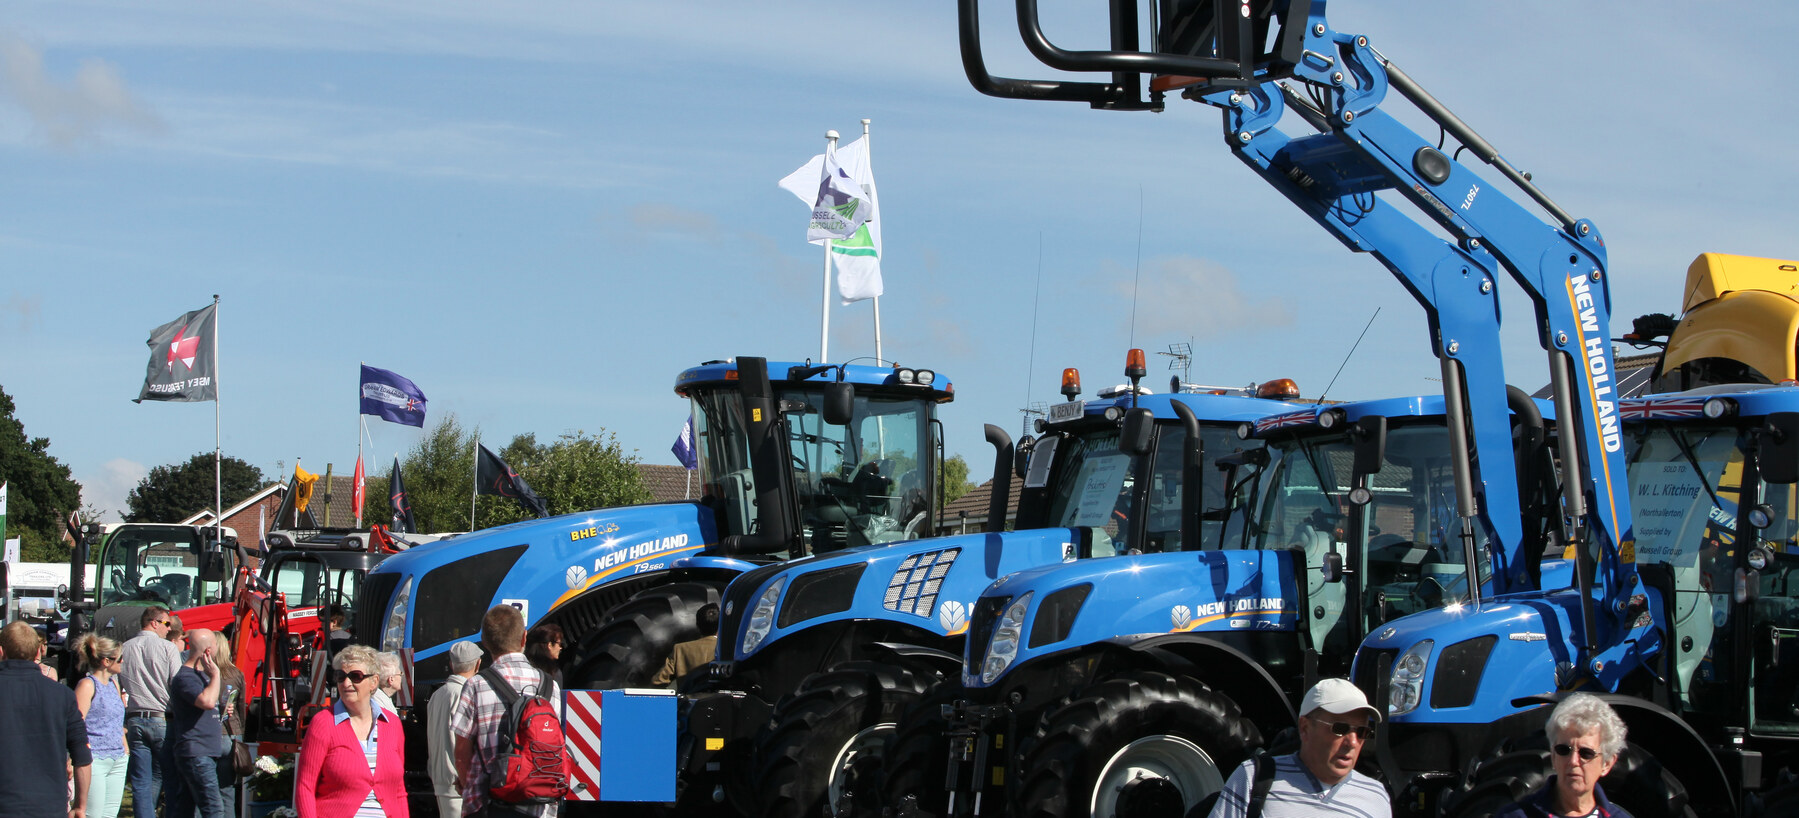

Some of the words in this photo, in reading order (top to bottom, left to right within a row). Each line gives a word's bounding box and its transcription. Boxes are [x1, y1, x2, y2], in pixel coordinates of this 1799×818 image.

[1461, 184, 1480, 210] 750TL
[1571, 274, 1599, 332] NEW
[1585, 337, 1621, 453] HOLLAND
[1638, 484, 1649, 496] W.
[1652, 485, 1659, 496] L.
[1662, 484, 1701, 499] Kitching
[1639, 508, 1684, 518] (Northallerton)
[571, 527, 597, 541] BHE
[1639, 528, 1663, 536] Supplied
[1664, 528, 1672, 536] by
[594, 548, 627, 572] NEW
[629, 534, 688, 560] HOLLAND
[1639, 546, 1661, 554] Russell
[1663, 547, 1682, 556] Group
[1197, 602, 1226, 617] NEW
[1230, 598, 1285, 612] HOLLAND
